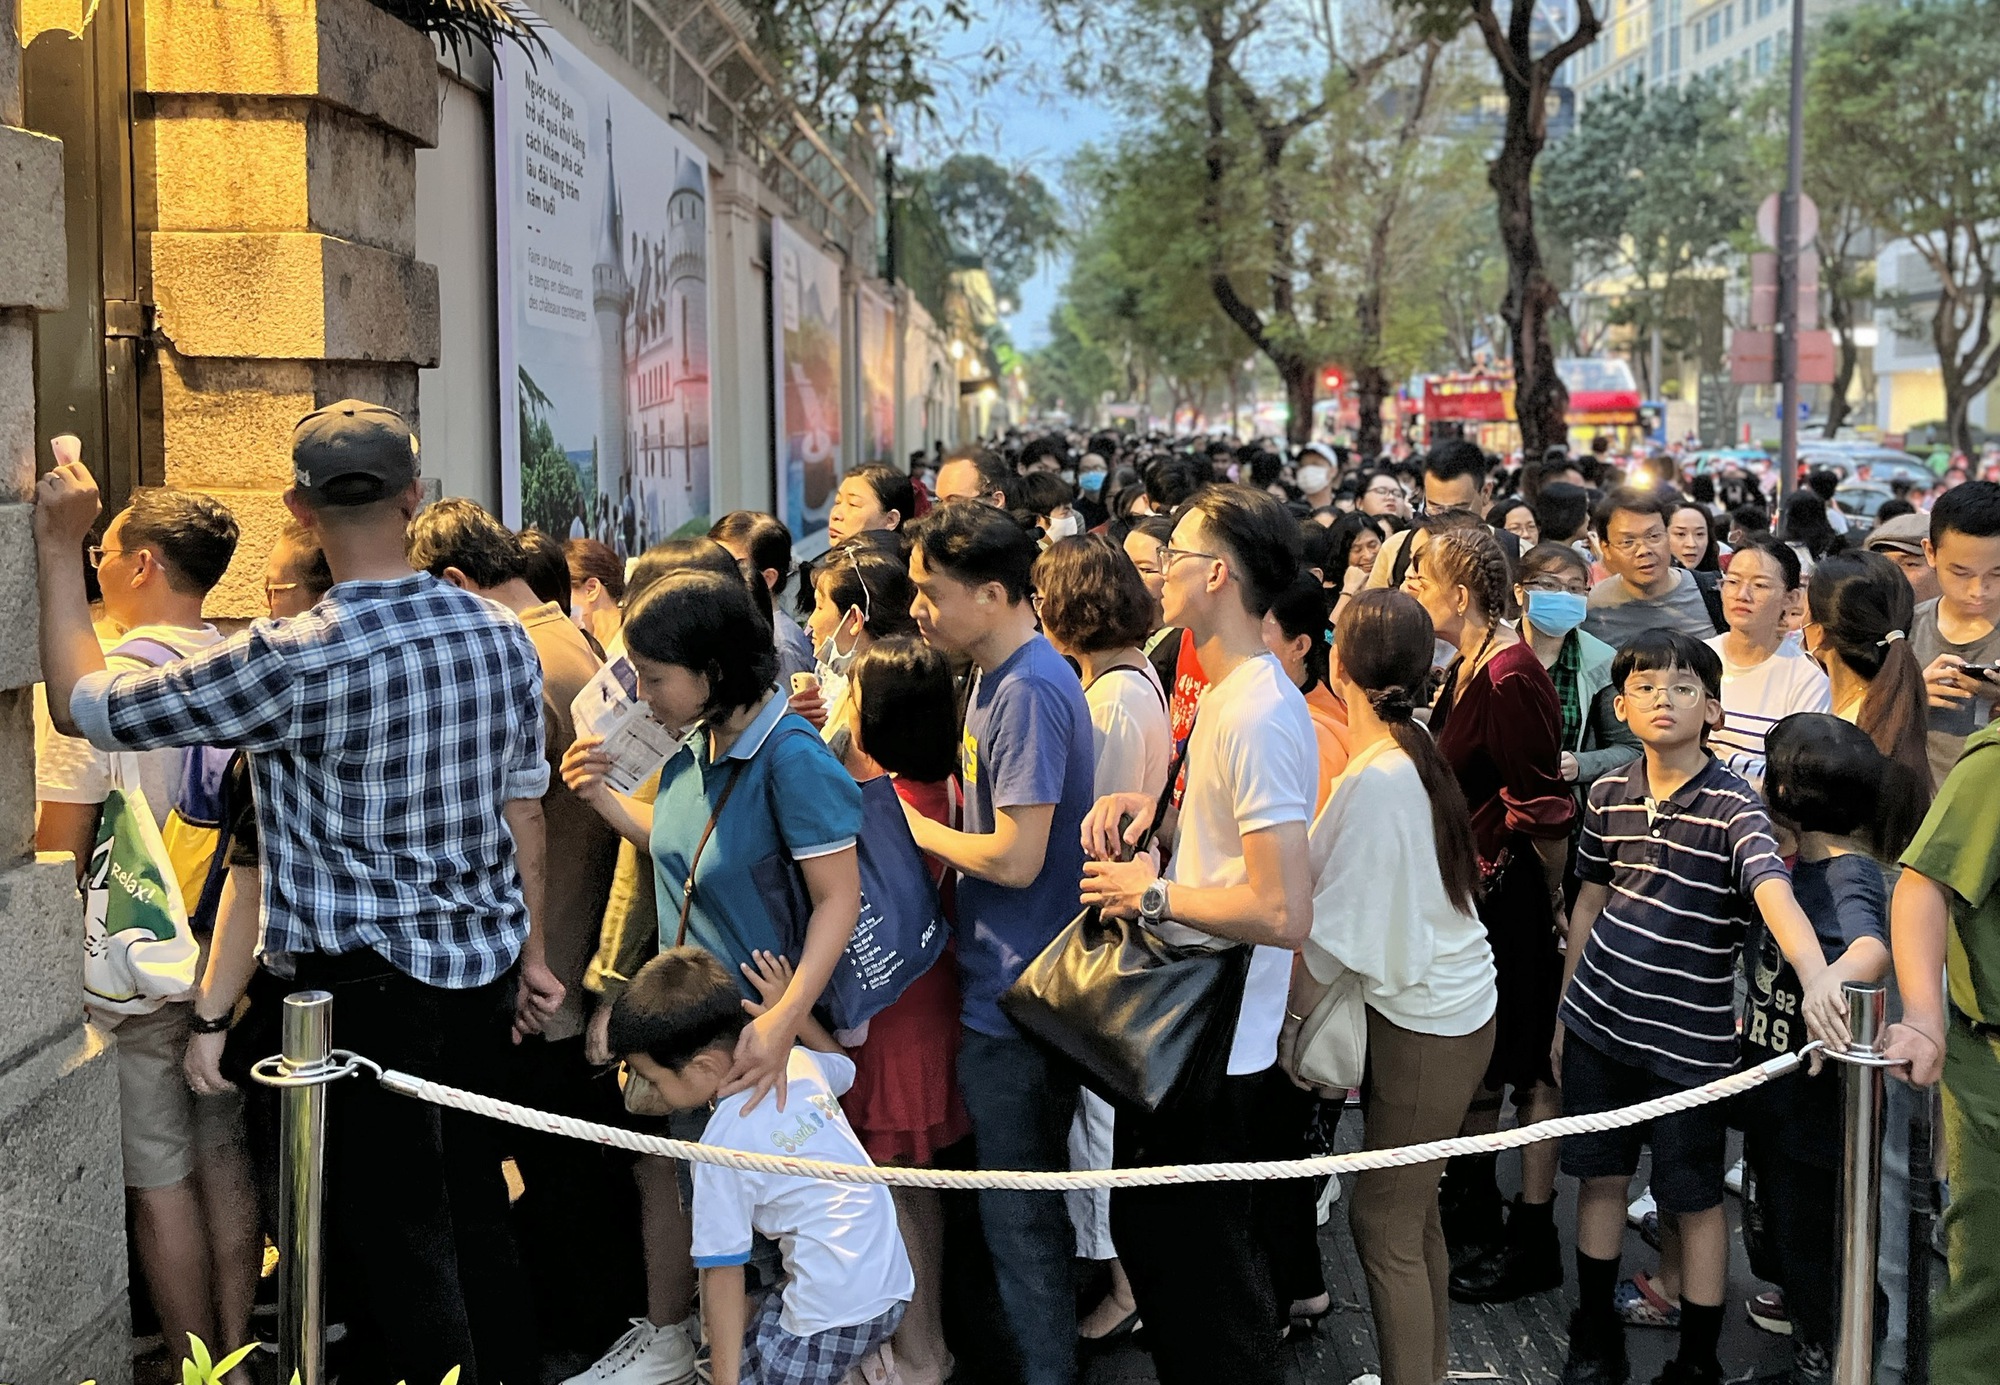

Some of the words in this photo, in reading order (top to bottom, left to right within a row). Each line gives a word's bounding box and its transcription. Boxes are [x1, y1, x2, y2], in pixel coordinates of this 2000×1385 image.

[525, 70, 546, 104] Ngược
[562, 98, 574, 121] gian
[525, 100, 536, 122] trở
[546, 118, 558, 138] quá
[526, 130, 541, 154] cách
[543, 137, 560, 165] khám
[561, 151, 573, 172] phá
[574, 159, 584, 178] các
[526, 155, 537, 179] lâu
[538, 164, 549, 186] đài
[549, 168, 565, 200] hàng
[566, 180, 580, 202] trăm
[527, 187, 541, 210] năm
[543, 195, 556, 216] tuổi
[528, 246, 540, 266] Faire
[541, 255, 547, 268] un
[549, 252, 561, 272] bond
[562, 259, 573, 277] dans
[528, 269, 533, 286] le
[534, 274, 550, 293] temps
[529, 293, 538, 310] des
[110, 862, 157, 904] Relax!
[1774, 988, 1797, 1016] 92
